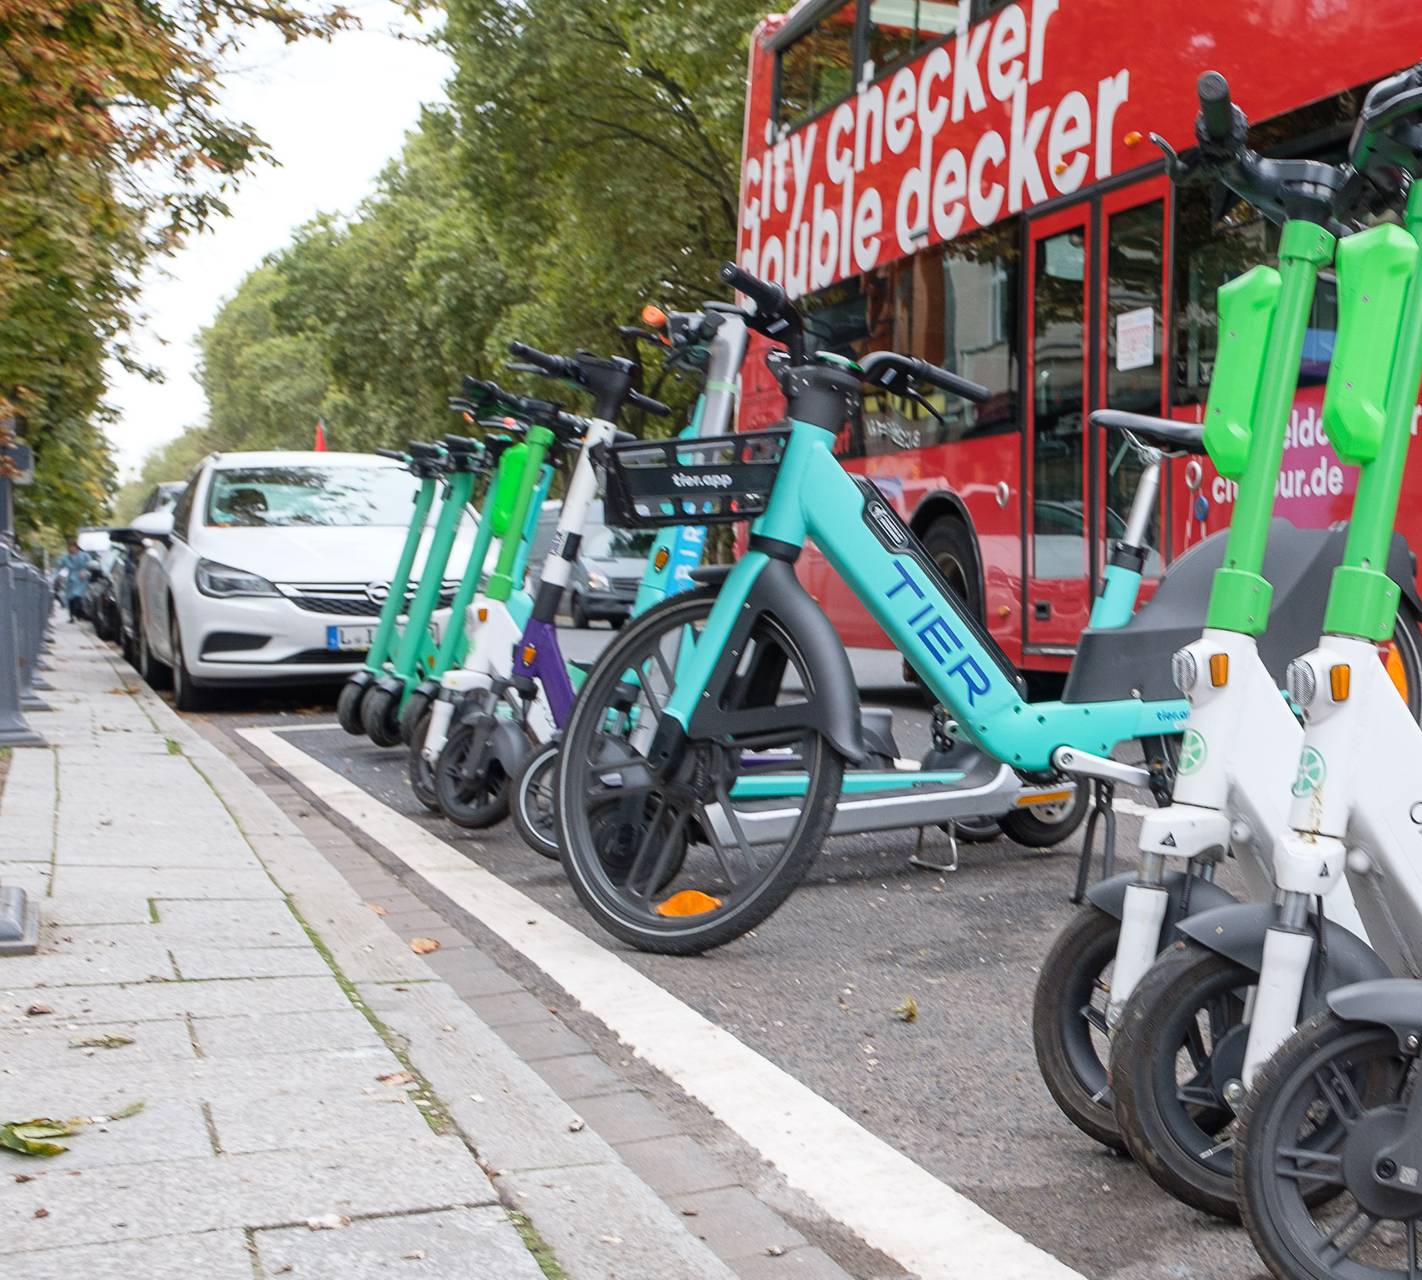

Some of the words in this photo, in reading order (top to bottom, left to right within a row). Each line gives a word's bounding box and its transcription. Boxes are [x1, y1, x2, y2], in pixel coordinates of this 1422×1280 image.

[740, 166, 882, 312] double
[896, 69, 1129, 254] decker
[743, 119, 817, 231] city
[827, 0, 1059, 184] checker
[885, 559, 991, 708] TIER
